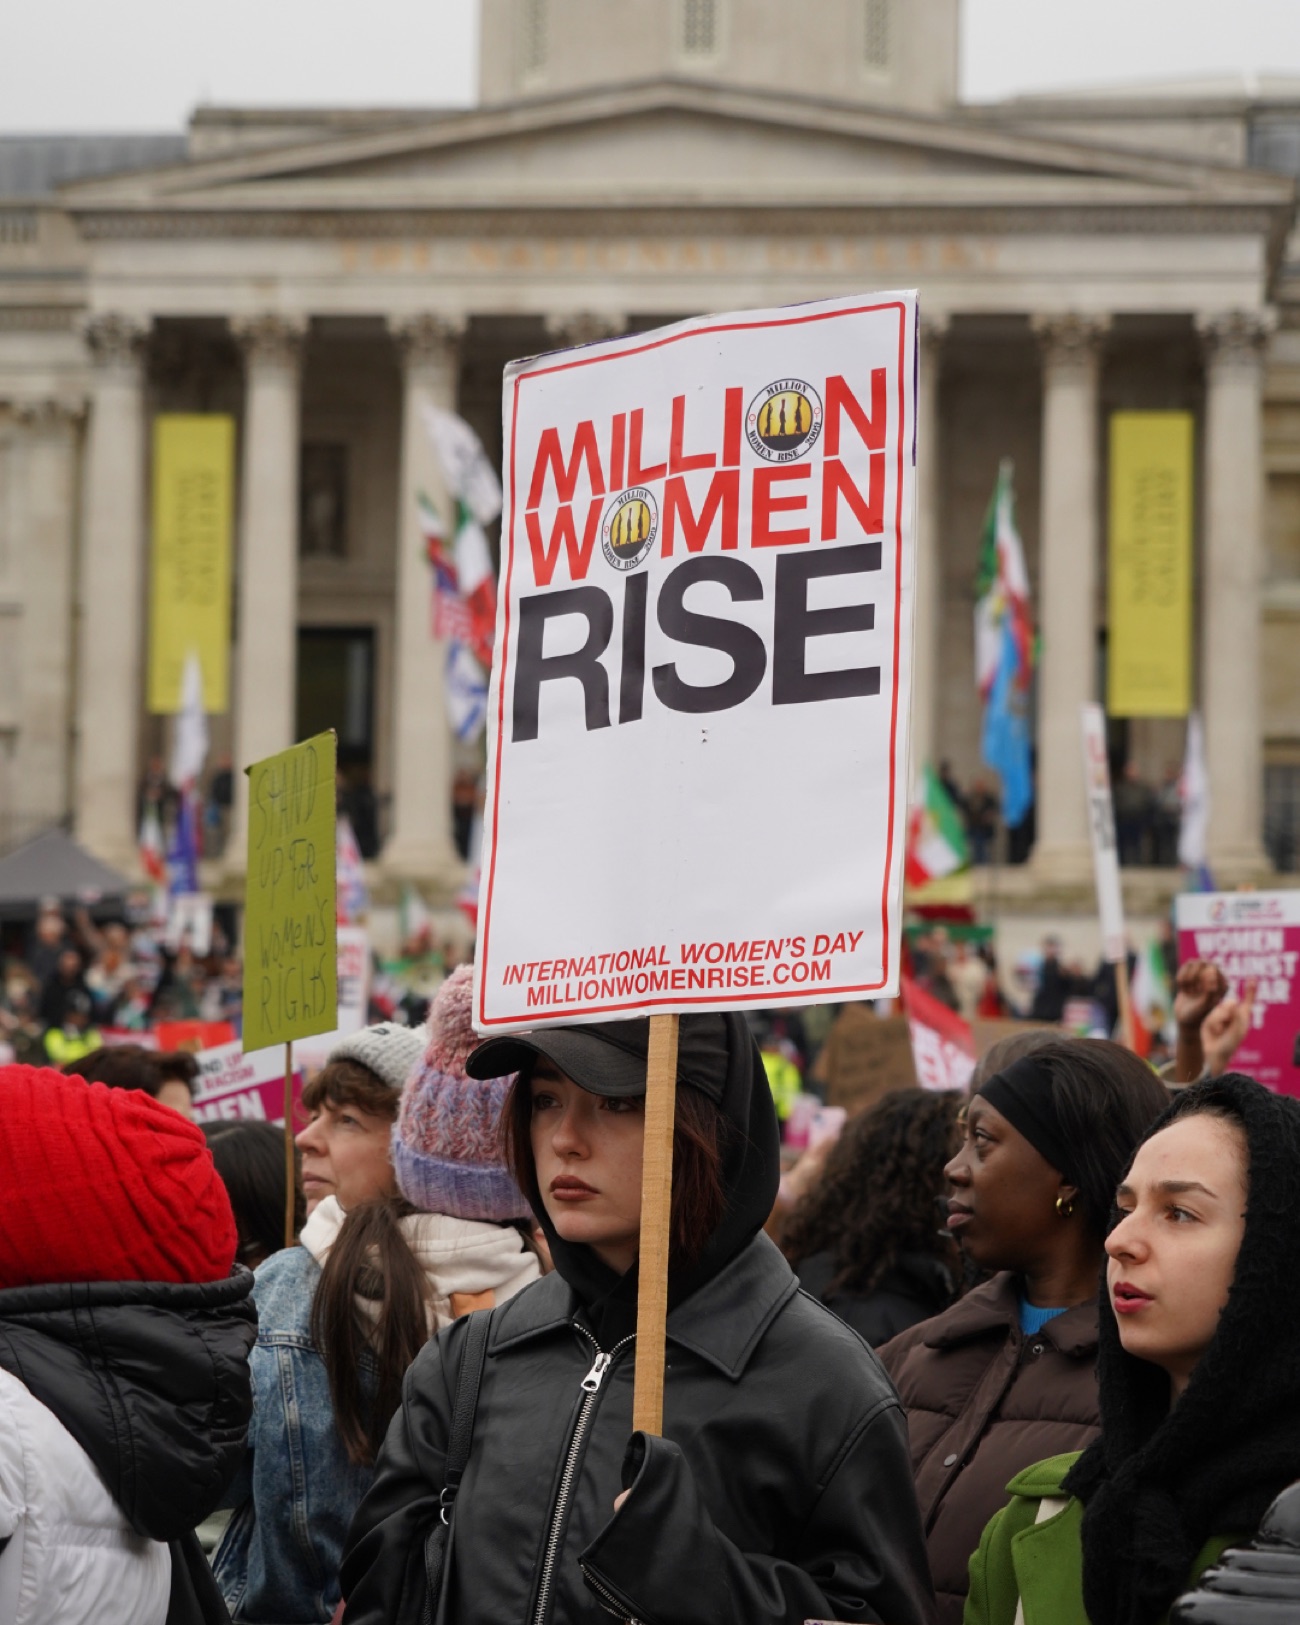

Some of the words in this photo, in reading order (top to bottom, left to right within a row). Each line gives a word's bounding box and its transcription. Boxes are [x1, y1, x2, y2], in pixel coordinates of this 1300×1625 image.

[766, 382, 808, 397] MILLION
[526, 368, 886, 510] MILLION
[748, 429, 774, 459] WOMEN
[777, 448, 800, 461] RISE
[525, 452, 885, 586] WOMEN
[512, 542, 882, 742] RISE
[259, 847, 284, 909] UP
[503, 945, 671, 985] INTERNATIONAL
[812, 930, 864, 957] DAY
[527, 959, 831, 1007] MILLIONWOMENRISE.COM
